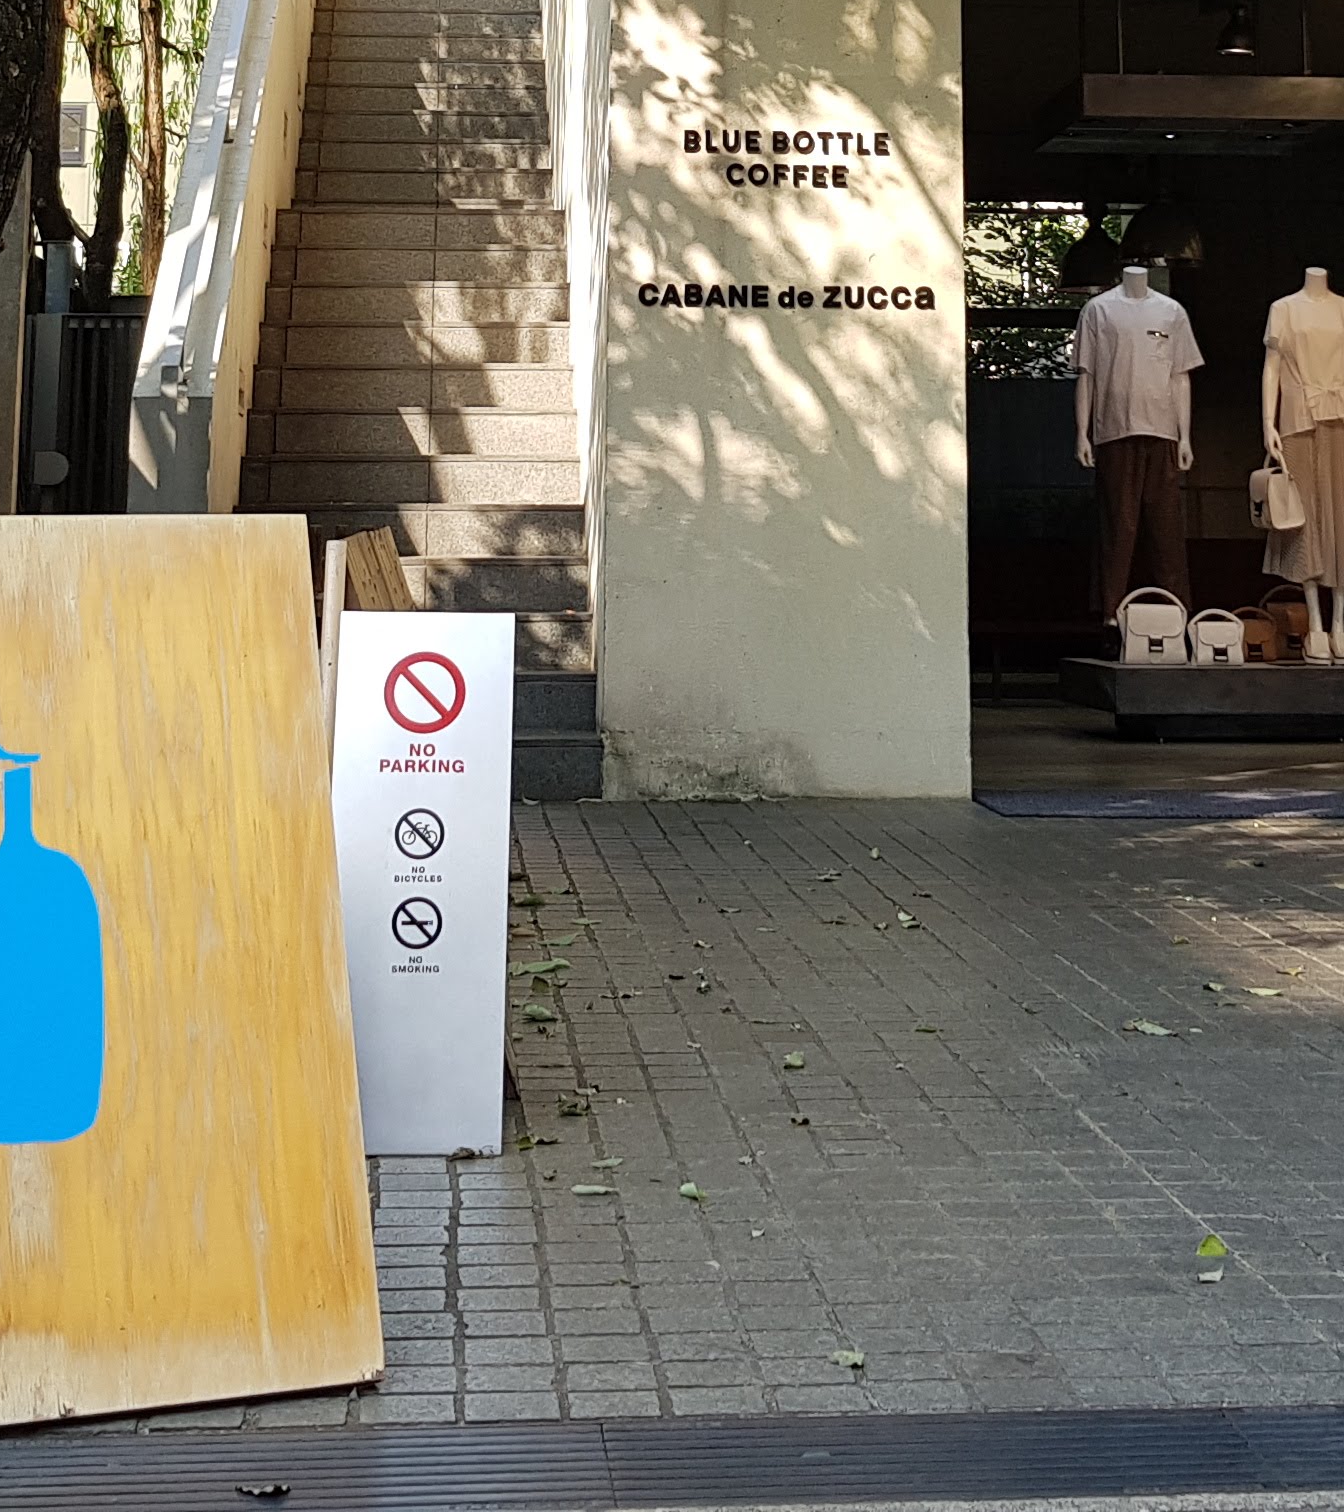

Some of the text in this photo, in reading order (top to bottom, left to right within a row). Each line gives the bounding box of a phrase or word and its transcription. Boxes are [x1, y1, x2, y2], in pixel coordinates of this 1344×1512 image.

[683, 129, 891, 156] BLUE BOTTLE
[725, 162, 850, 189] COFFEE
[637, 282, 770, 309] CABANE
[777, 285, 815, 309] de
[409, 743, 436, 757] NO
[379, 758, 465, 774] PARKING
[411, 866, 426, 874] NO
[393, 874, 443, 883] BICYCLES
[408, 955, 423, 964] NO
[391, 964, 440, 974] SMOKING
